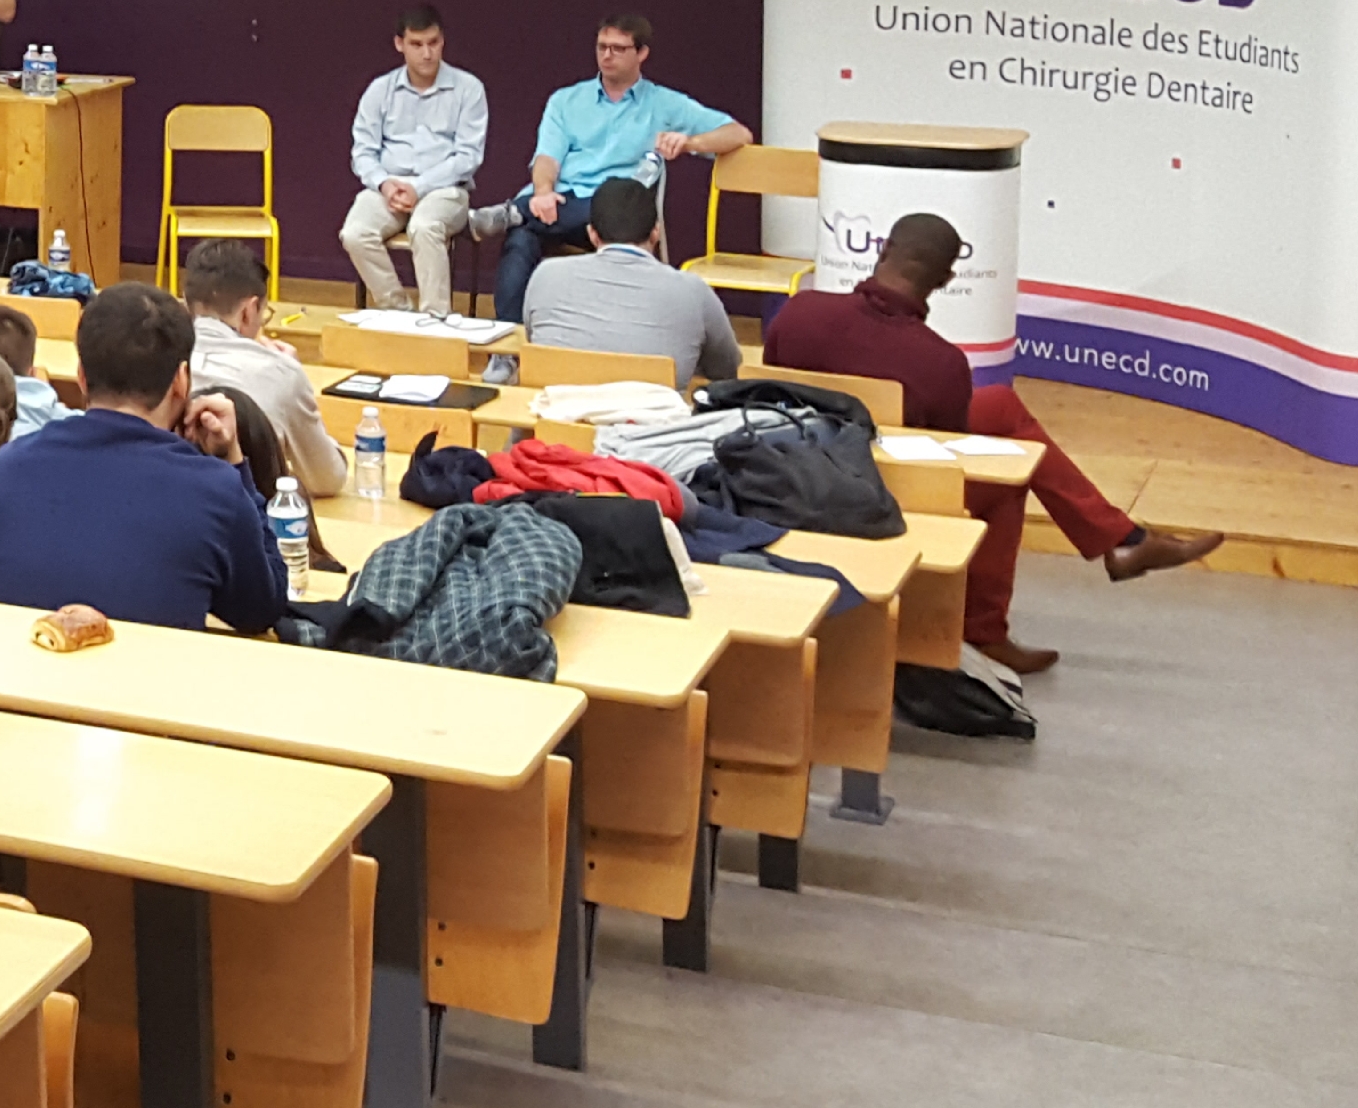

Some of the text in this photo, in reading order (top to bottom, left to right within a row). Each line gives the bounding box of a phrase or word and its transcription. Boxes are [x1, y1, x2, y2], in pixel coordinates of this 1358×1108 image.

[874, 4, 1300, 75] Union Nationale des Etudiants
[948, 56, 1255, 115] en Chirurgie Dentaire
[1014, 337, 1210, 392] ww.unecd.com
